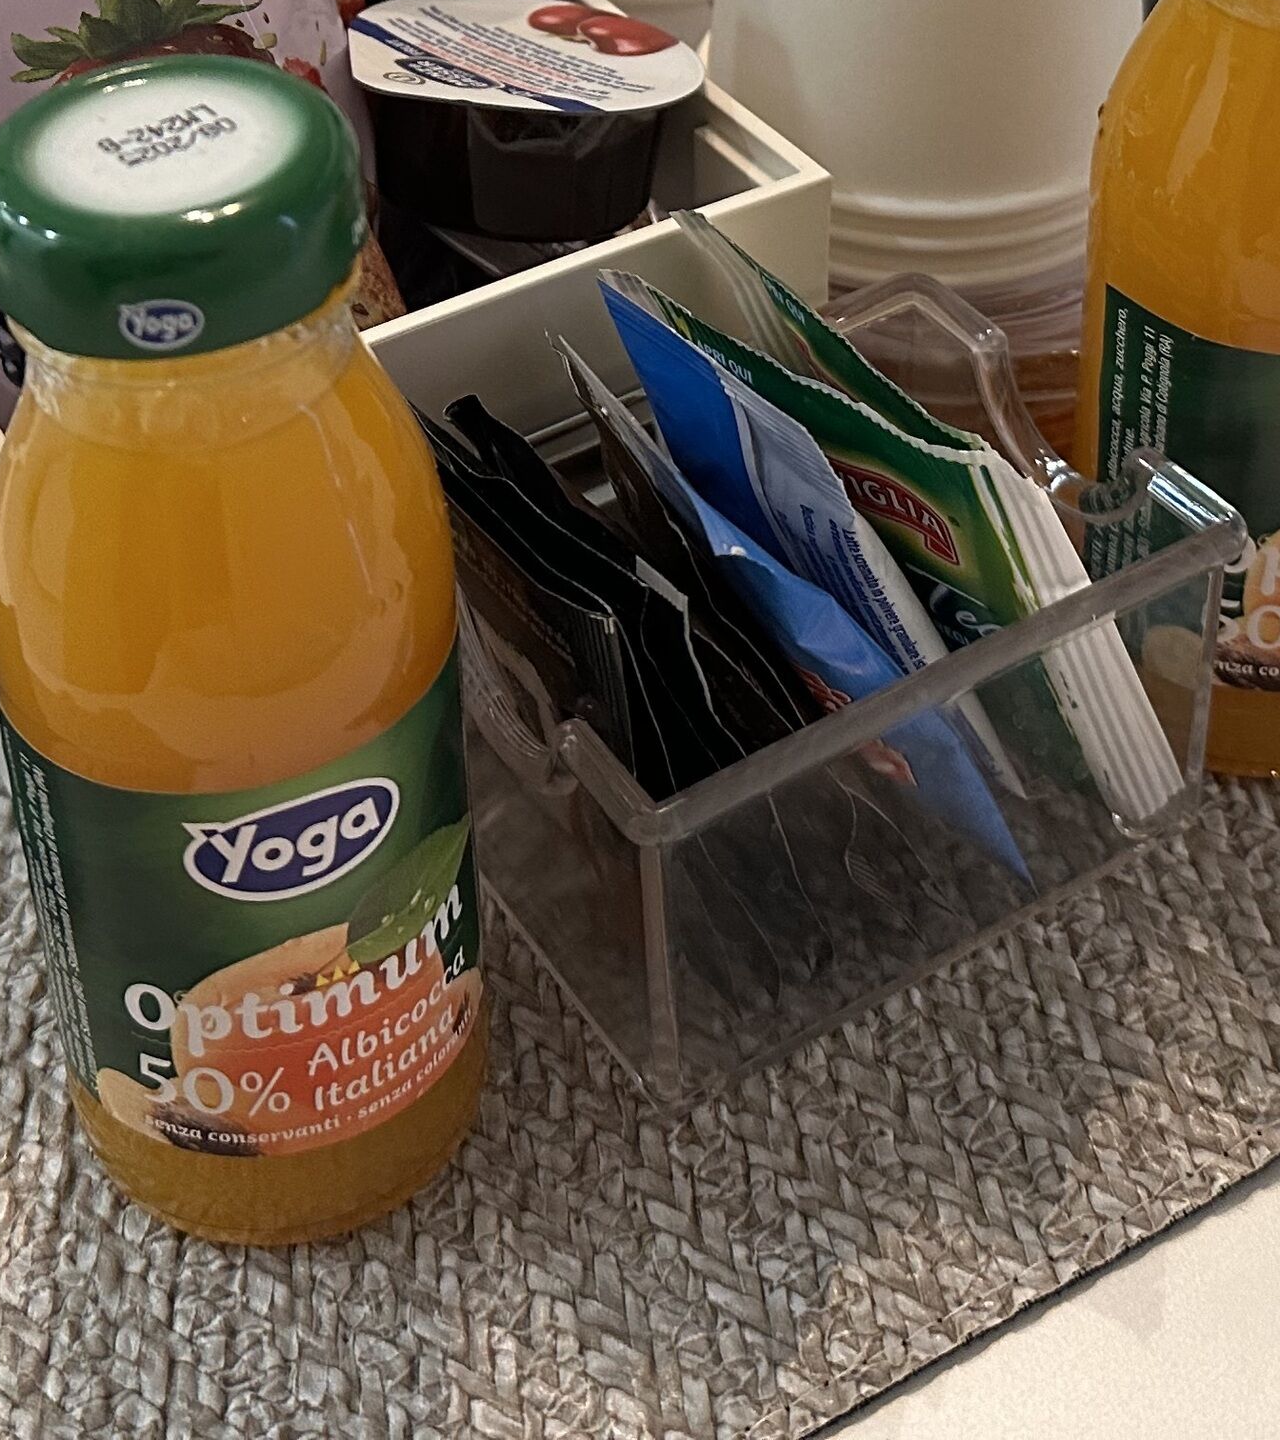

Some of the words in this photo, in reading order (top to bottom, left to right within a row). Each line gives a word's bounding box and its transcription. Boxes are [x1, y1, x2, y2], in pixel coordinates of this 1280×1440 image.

[129, 306, 194, 341] Yoga
[1115, 308, 1129, 371] zucchero,
[1143, 325, 1156, 340] 11
[1142, 340, 1157, 375] Poggi
[1158, 333, 1175, 360] (RA)
[728, 360, 754, 386] QUI
[1111, 373, 1125, 417] acqua,
[1140, 386, 1153, 406] Via
[839, 471, 948, 548] IGLIA
[1217, 660, 1255, 677] nza
[206, 796, 382, 886] Yoga
[123, 883, 464, 1058] Optimum
[138, 1052, 292, 1118] 50%
[306, 944, 467, 1078] Albicocca
[312, 1000, 455, 1112] Italiana
[143, 1113, 203, 1142] senza
[206, 1113, 342, 1146] conservanti
[356, 1077, 414, 1118] senza
